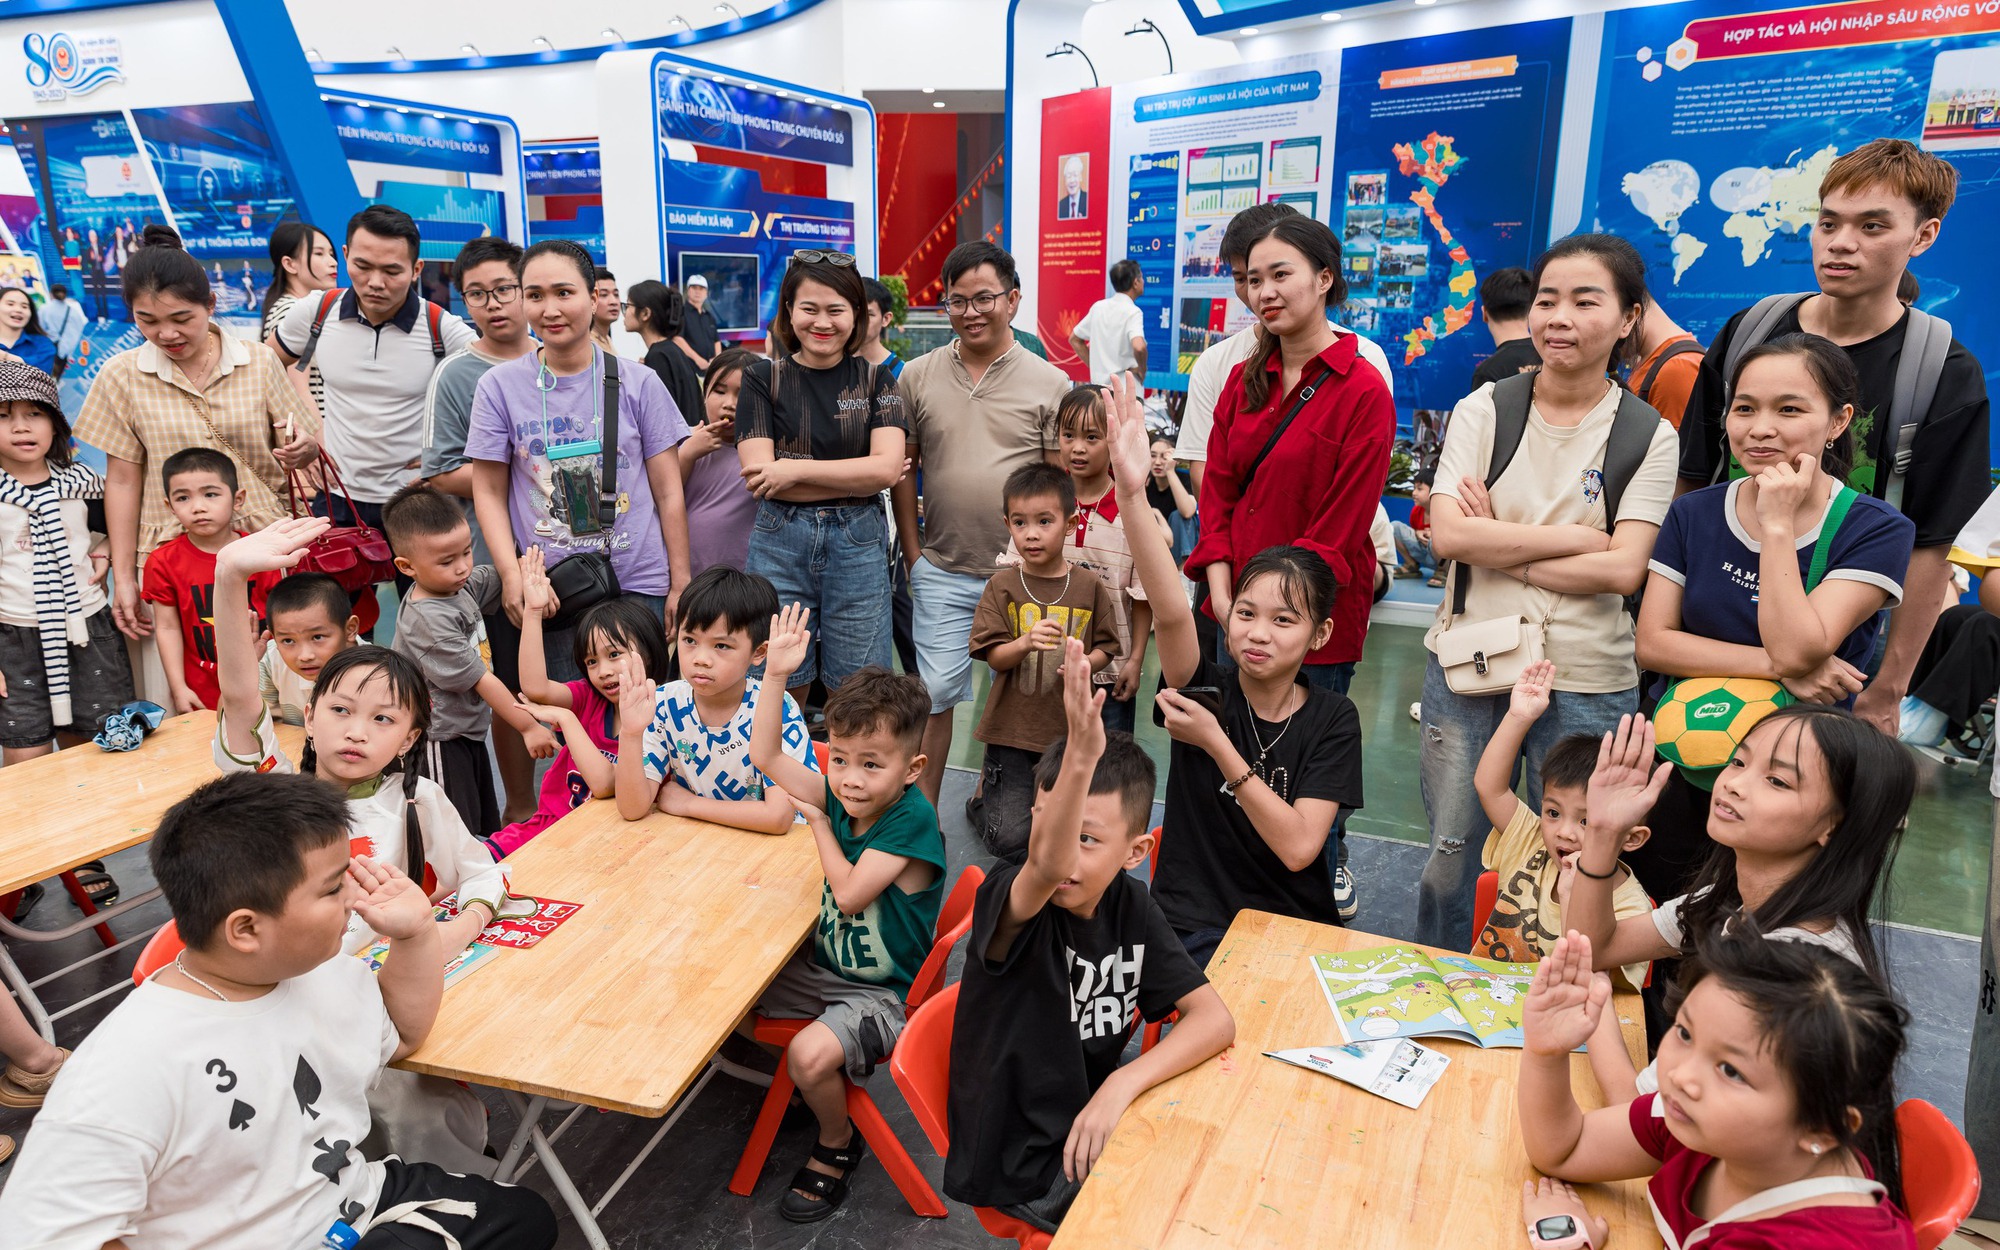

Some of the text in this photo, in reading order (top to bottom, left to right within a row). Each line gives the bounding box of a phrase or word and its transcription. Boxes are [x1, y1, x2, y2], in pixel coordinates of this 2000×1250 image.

[1723, 28, 1755, 45] HỢP
[1758, 23, 1785, 39] TÁC
[1788, 19, 1806, 36] VÀ
[1809, 17, 1838, 36] HỘI
[1840, 12, 1884, 31] NHẬP
[1886, 8, 1918, 25] SÂU
[1921, 4, 1970, 23] RỘNG
[1142, 102, 1154, 113] VAI
[1154, 98, 1168, 111] TRÒ
[1197, 95, 1208, 105] AN
[1208, 93, 1226, 104] SINH
[1238, 88, 1252, 101] HỘI
[1254, 84, 1270, 97] CỦA
[1271, 83, 1289, 96] VIỆT
[1290, 81, 1309, 92] NAM
[686, 101, 699, 117] TÀI
[744, 114, 771, 131] PHONG
[771, 119, 796, 136] TRONG
[796, 124, 823, 140] CHUYỂN
[835, 128, 845, 145] SỐ
[360, 128, 395, 144] PHONG
[395, 132, 427, 147] TRONG
[669, 211, 686, 225] BẢO
[687, 211, 707, 227] HIỂM
[719, 215, 734, 231] HỘI
[1697, 704, 1728, 716] MILO
[717, 739, 743, 756] ROAR
[206, 1058, 237, 1093] 3
